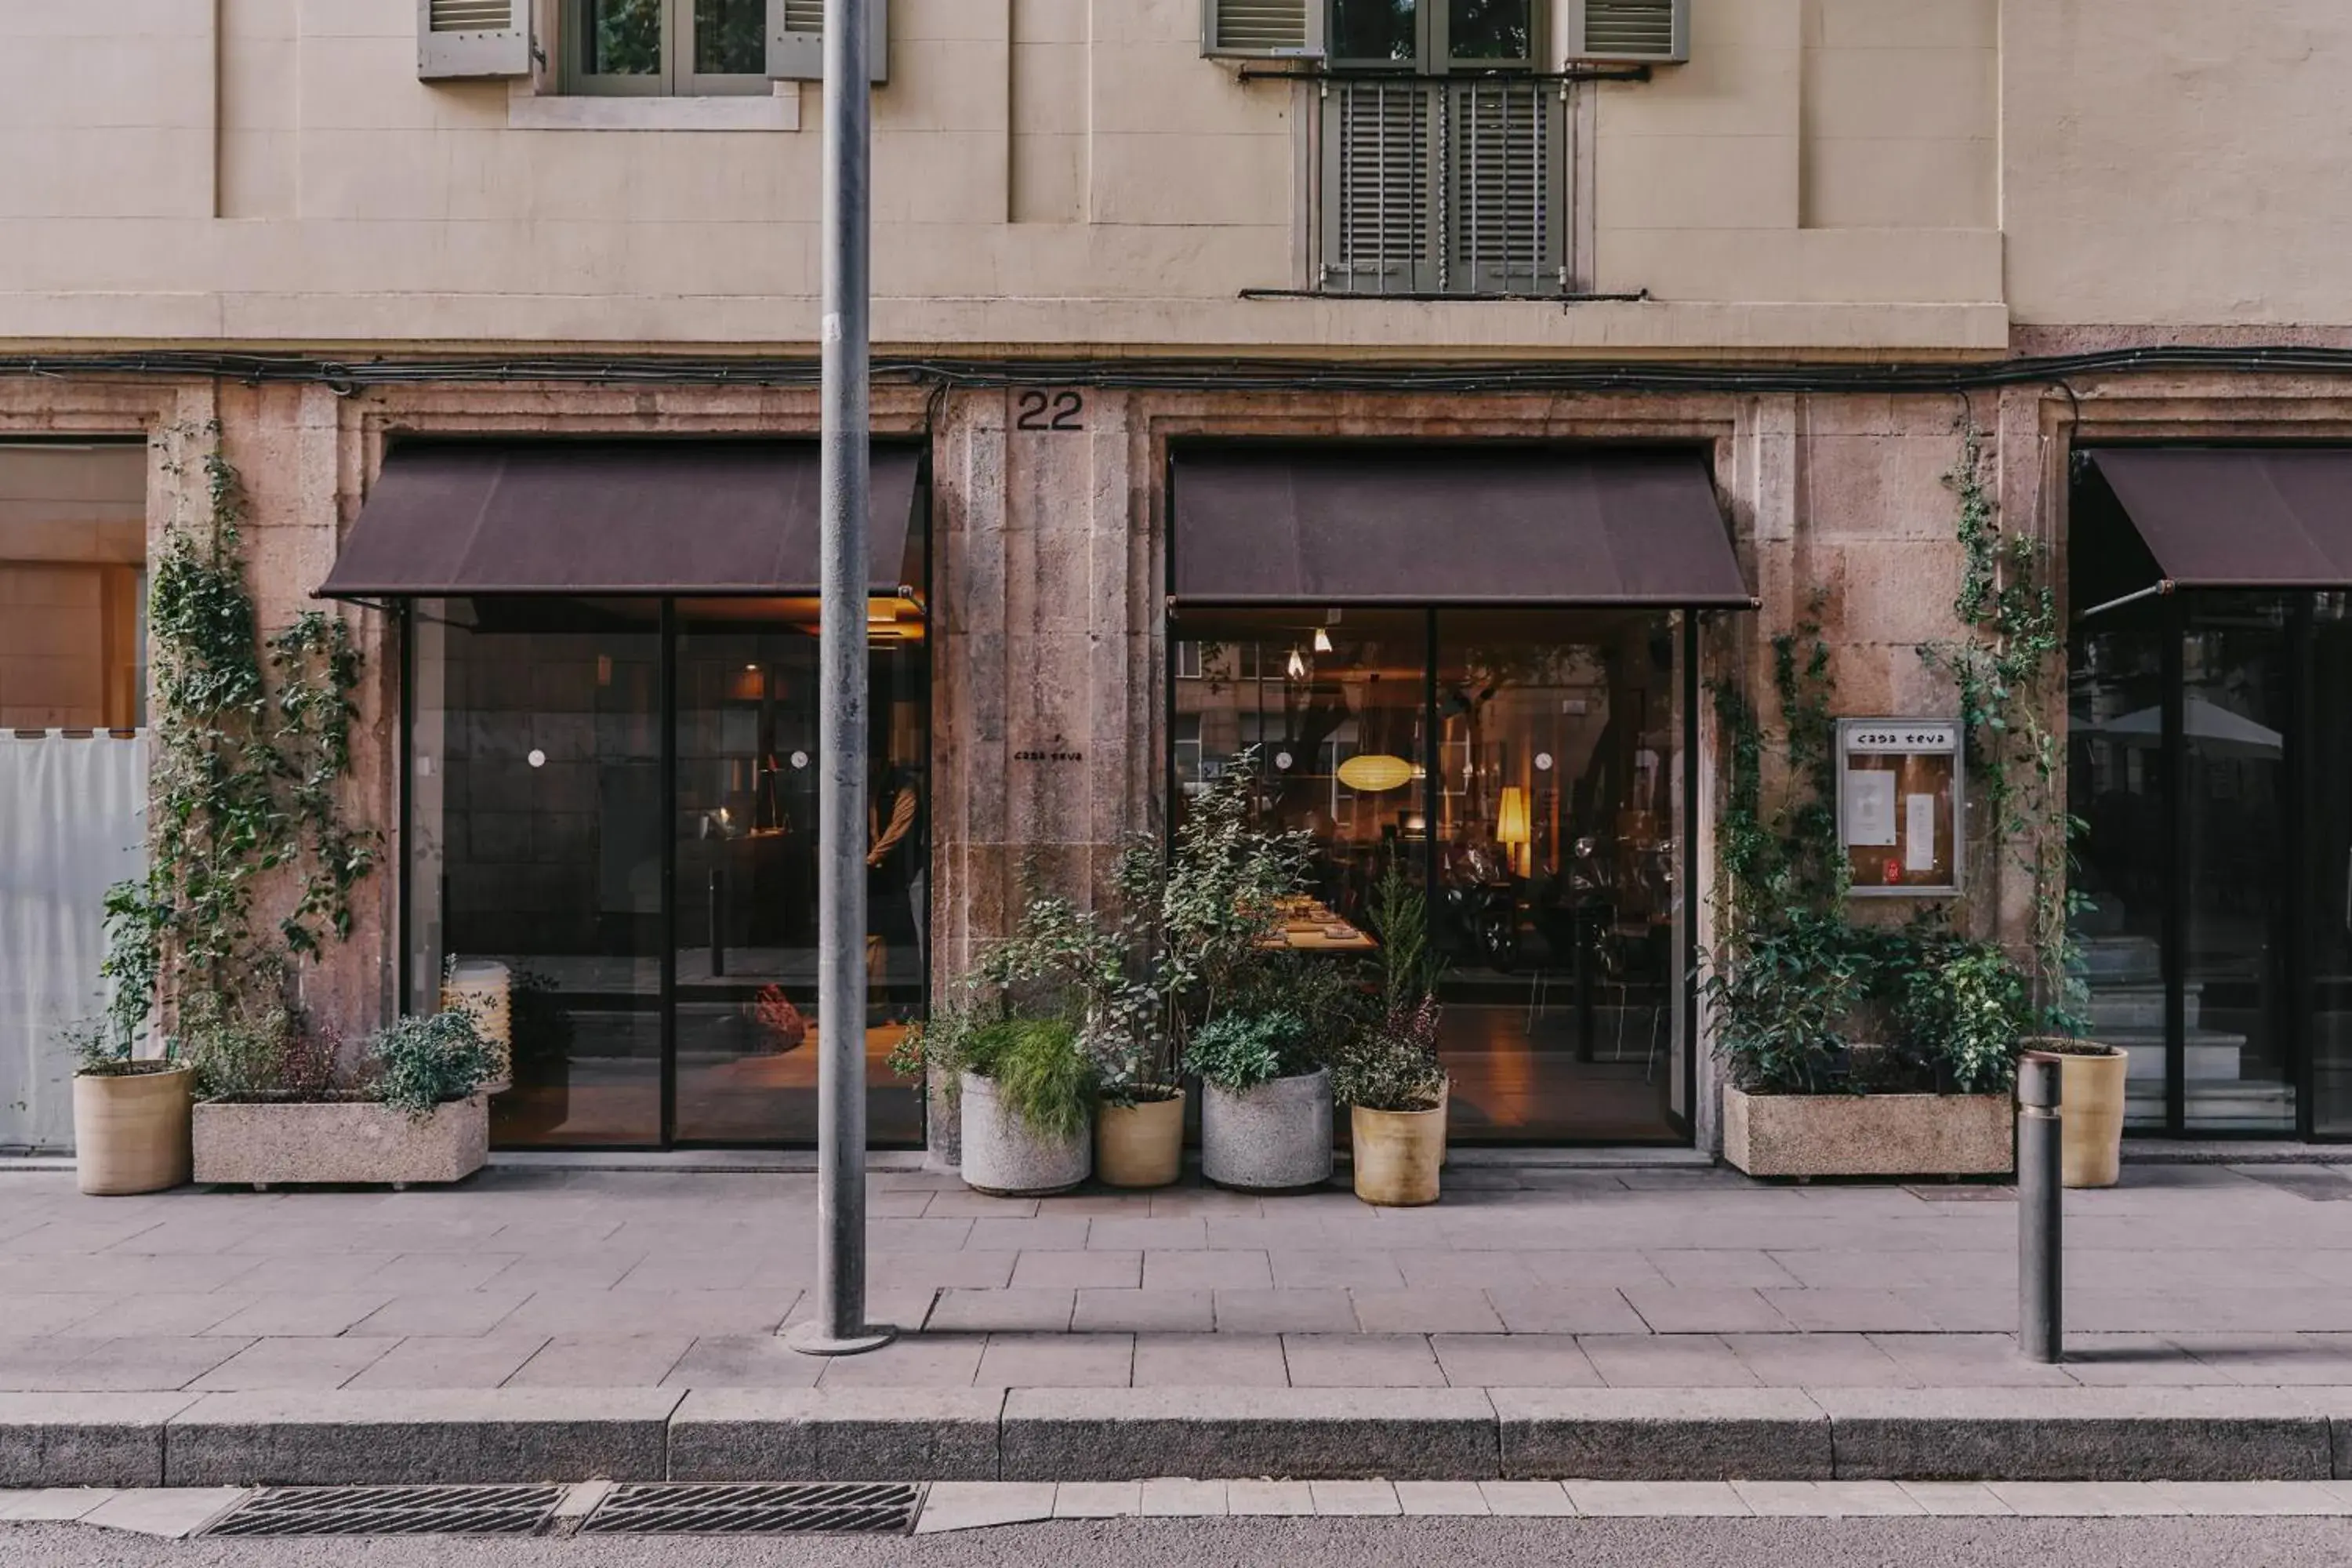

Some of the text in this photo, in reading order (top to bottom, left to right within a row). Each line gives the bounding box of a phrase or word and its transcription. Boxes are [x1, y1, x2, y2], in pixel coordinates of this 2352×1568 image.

[1018, 390, 1083, 430] 22
[1857, 734, 1945, 743] casa teva
